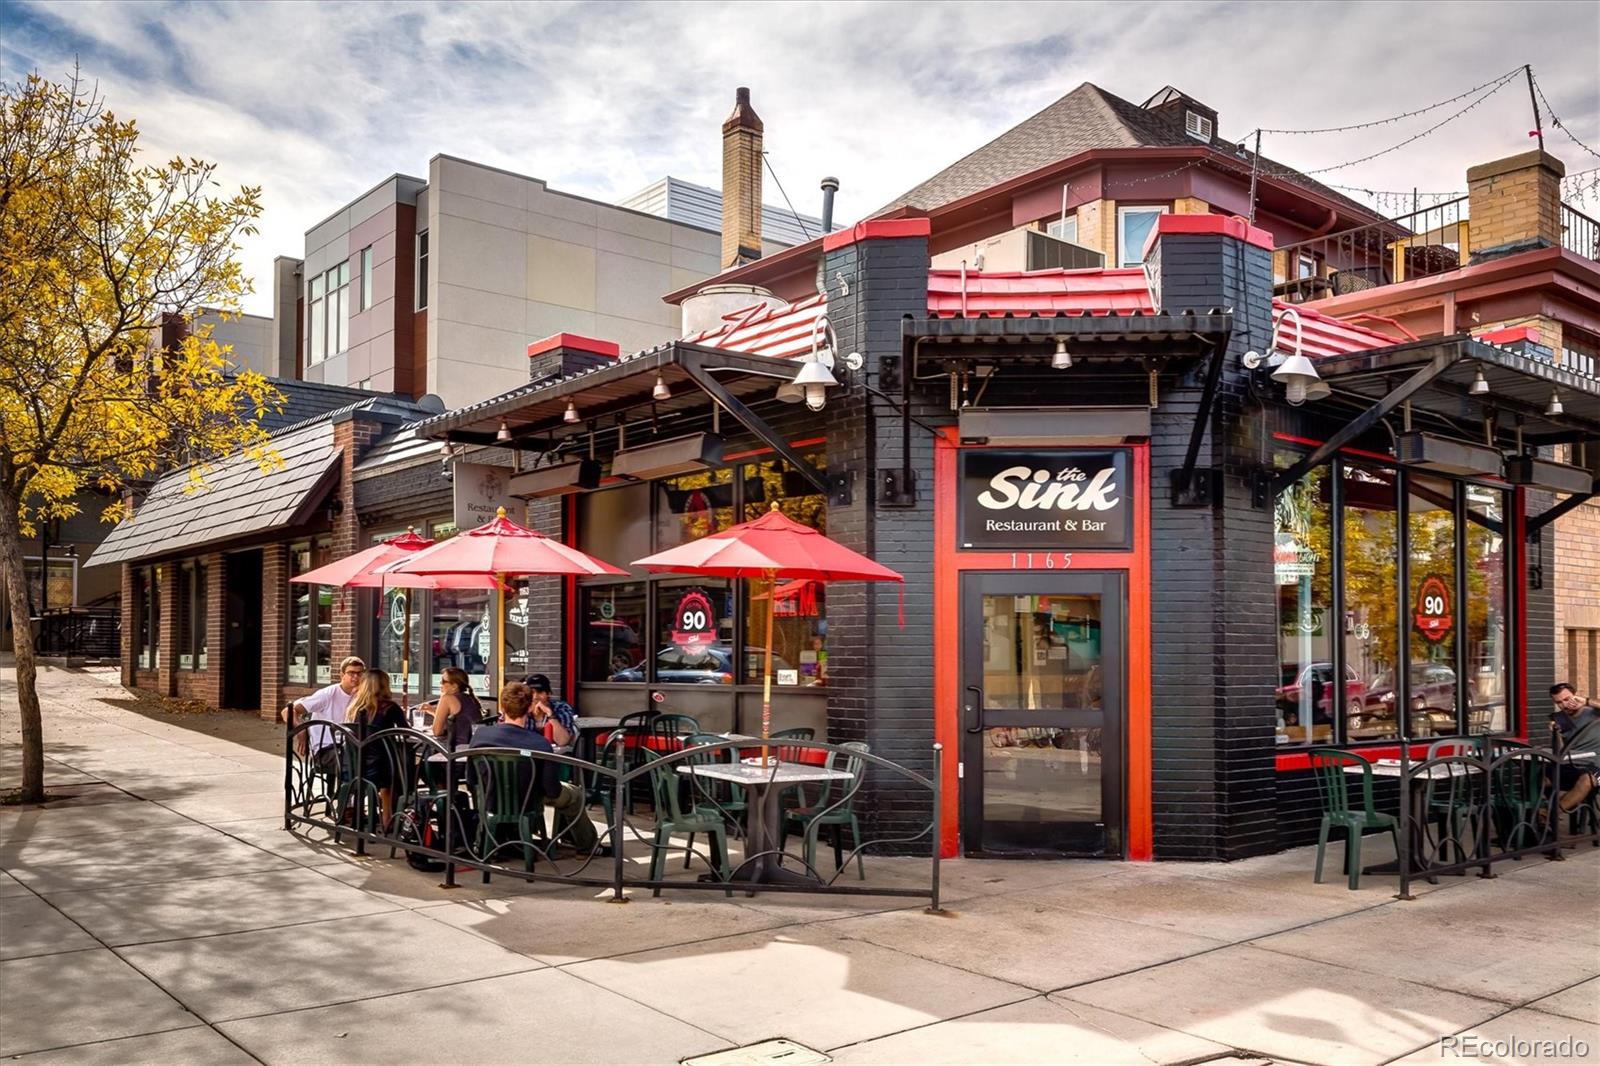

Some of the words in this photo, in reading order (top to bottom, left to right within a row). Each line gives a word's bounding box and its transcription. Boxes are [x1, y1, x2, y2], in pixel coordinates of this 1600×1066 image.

[1056, 467, 1087, 482] the
[977, 466, 1119, 511] Sink
[986, 519, 1061, 532] Restaurant
[1064, 519, 1078, 532] &
[1082, 519, 1107, 532] Bar
[1010, 552, 1073, 569] 1165
[1425, 595, 1444, 615] 90
[683, 611, 706, 630] 90
